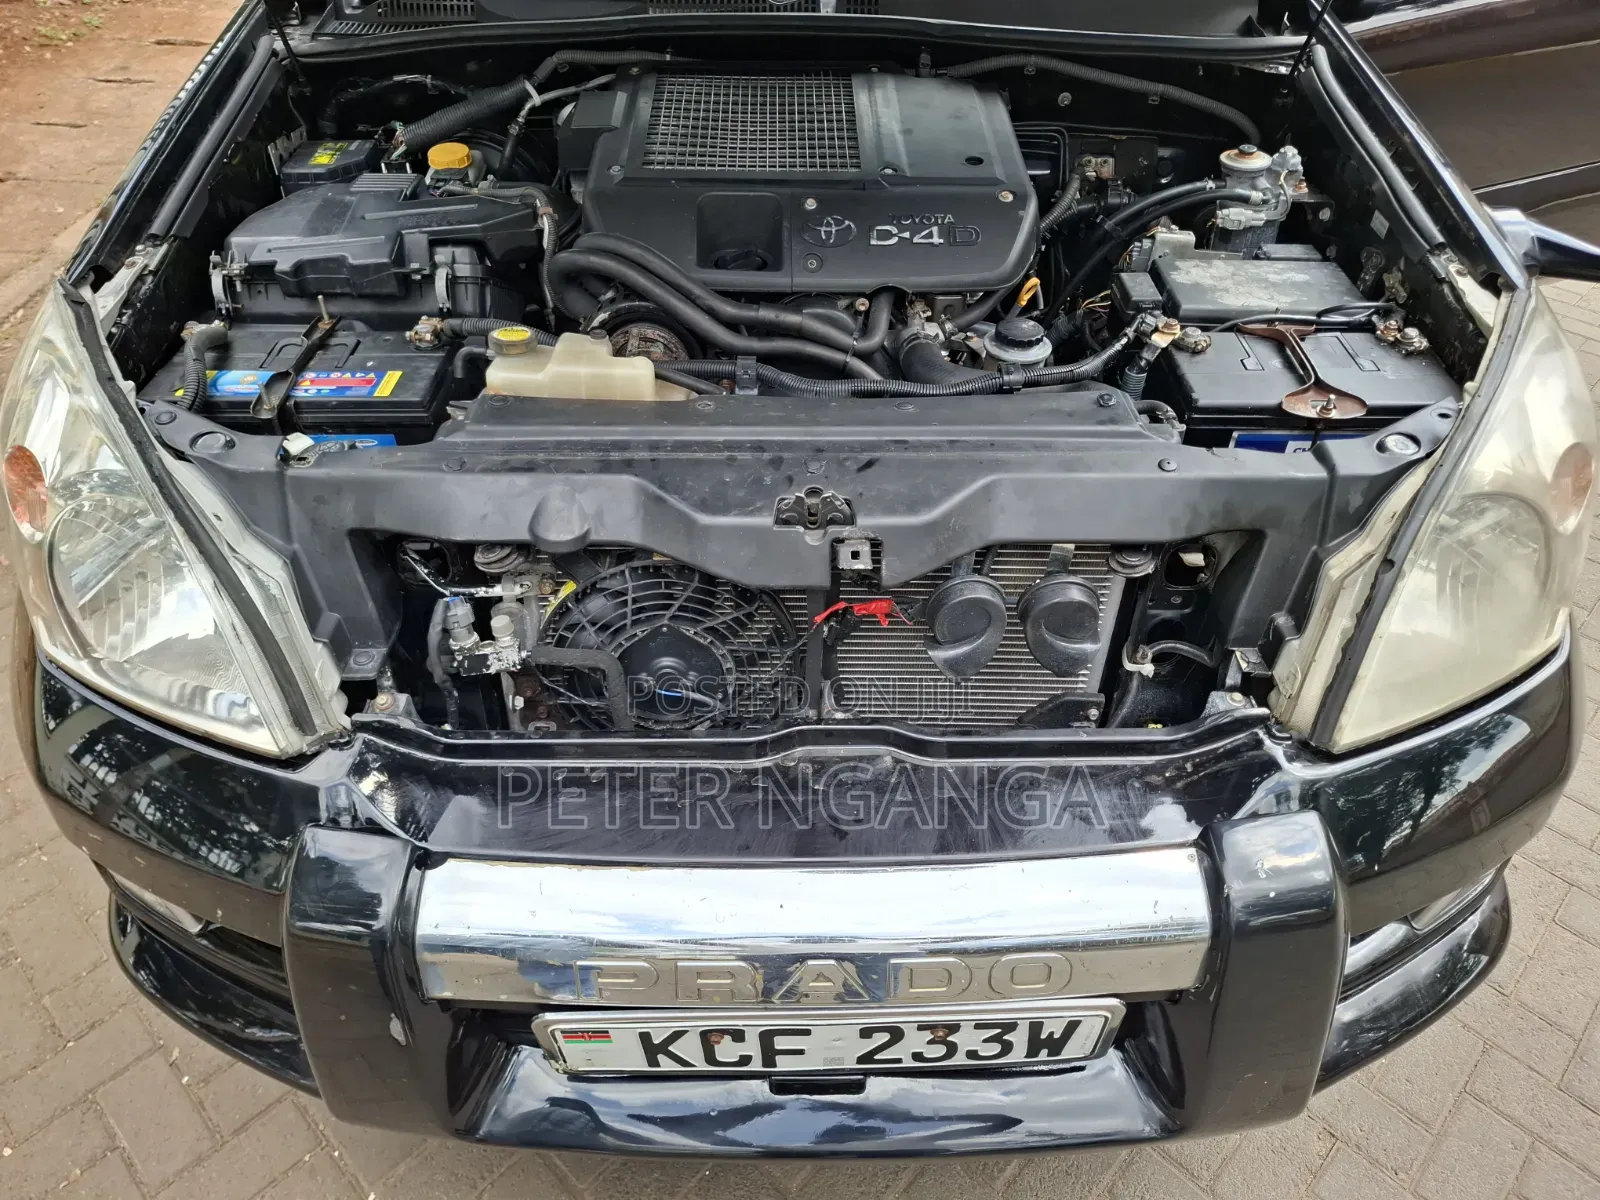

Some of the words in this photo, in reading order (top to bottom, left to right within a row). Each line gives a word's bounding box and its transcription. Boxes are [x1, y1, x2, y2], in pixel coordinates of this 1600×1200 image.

[869, 225, 982, 247] D-4D
[888, 213, 955, 225] TOYOTA
[574, 951, 1074, 1002] PRADO
[637, 1027, 813, 1069] KCF
[855, 1019, 1083, 1067] 233W
